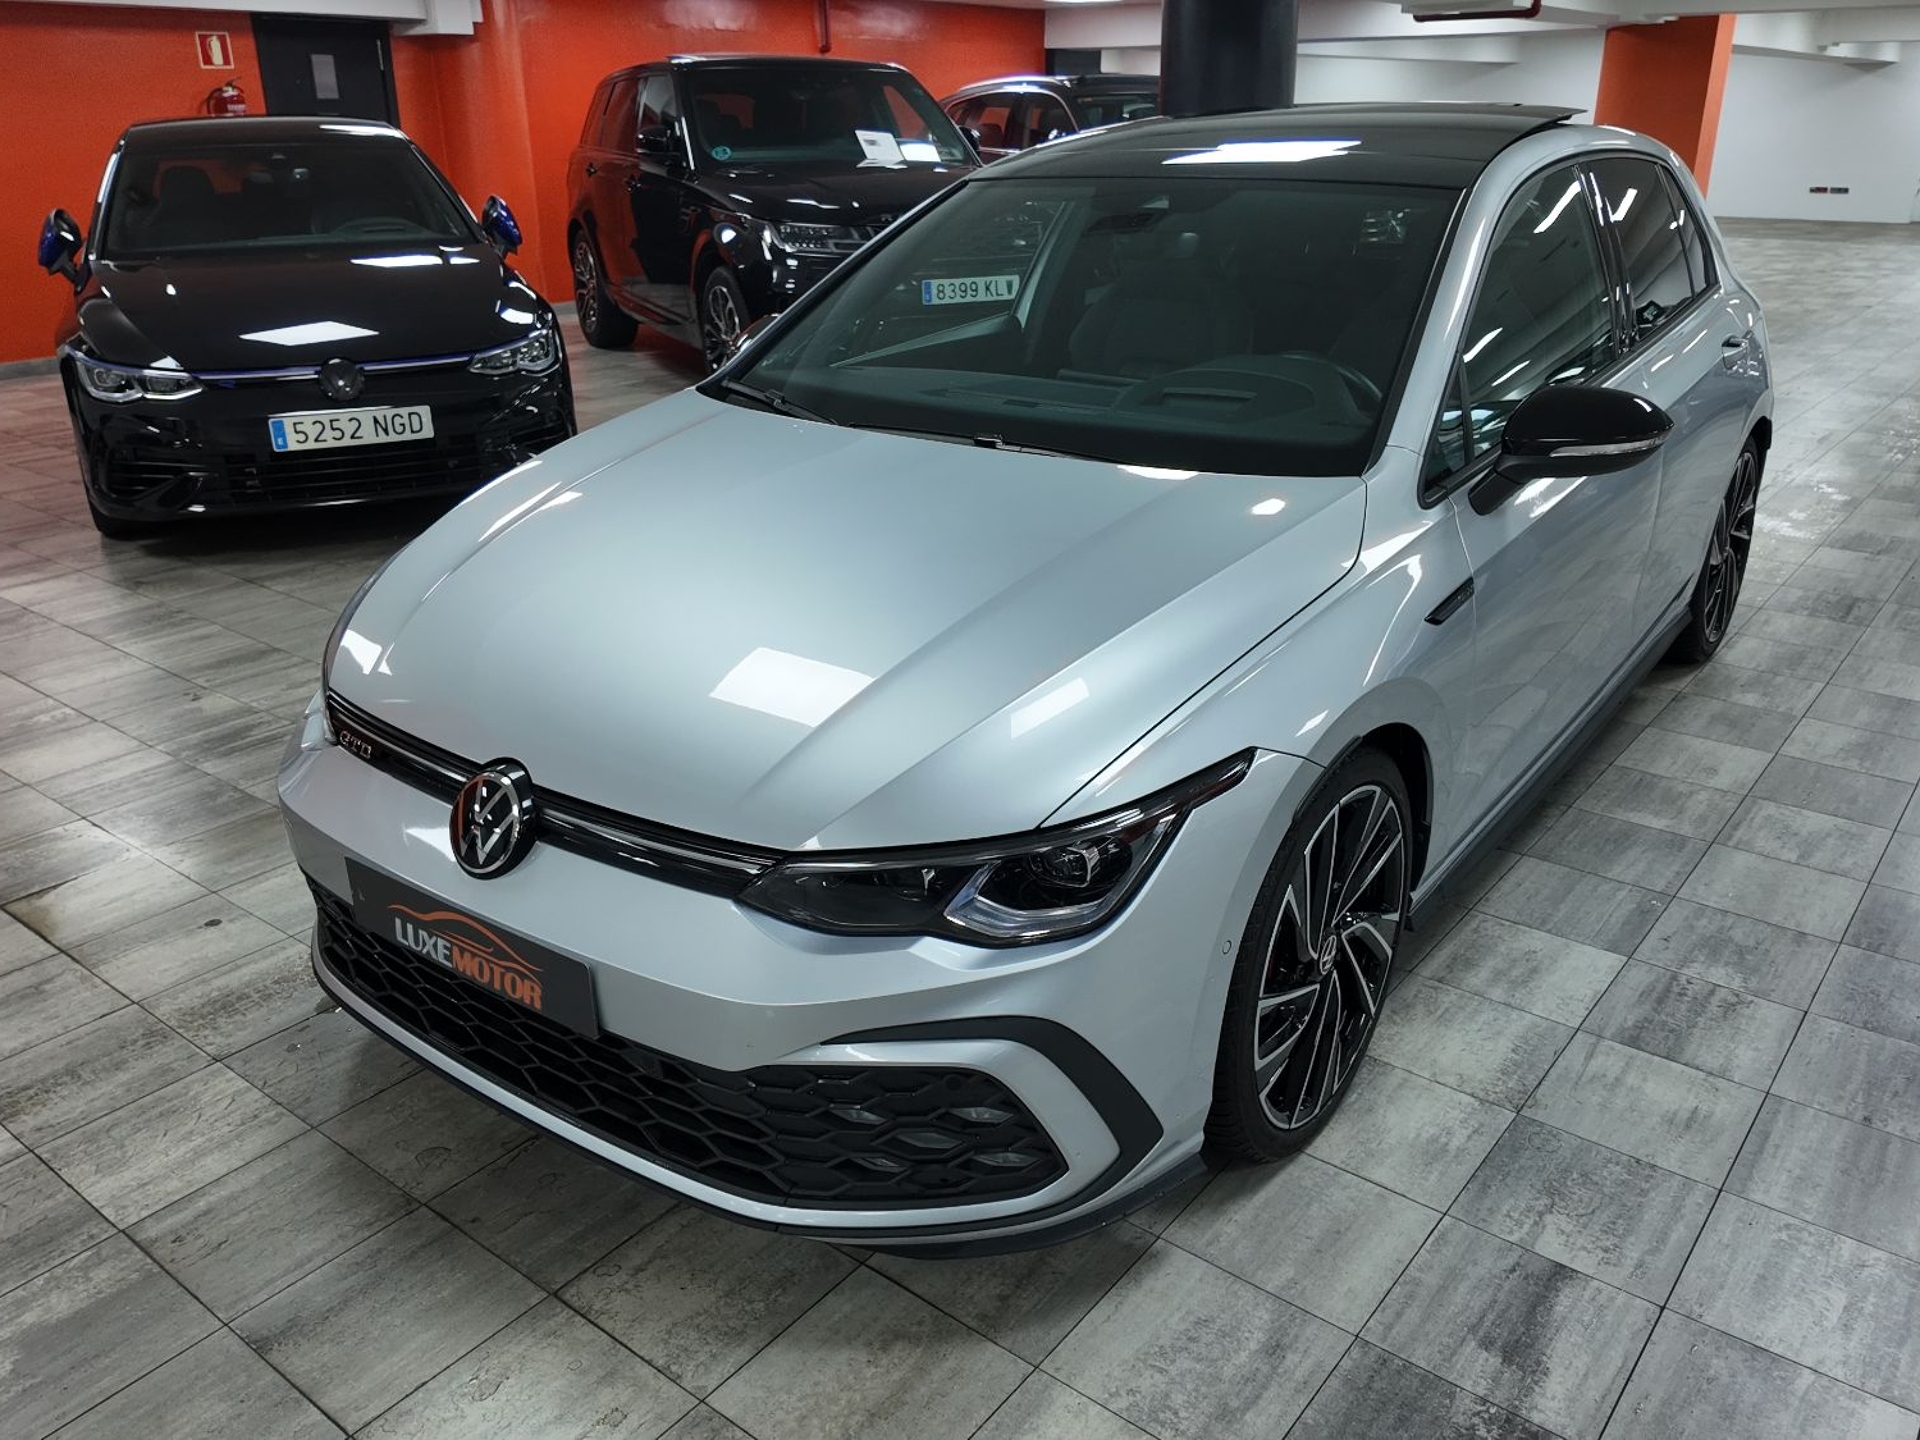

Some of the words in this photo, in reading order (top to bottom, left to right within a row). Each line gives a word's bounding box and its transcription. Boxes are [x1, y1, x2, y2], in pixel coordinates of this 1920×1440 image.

[936, 281, 979, 300] 8399
[292, 416, 364, 444] 5252
[372, 411, 424, 438] NGD
